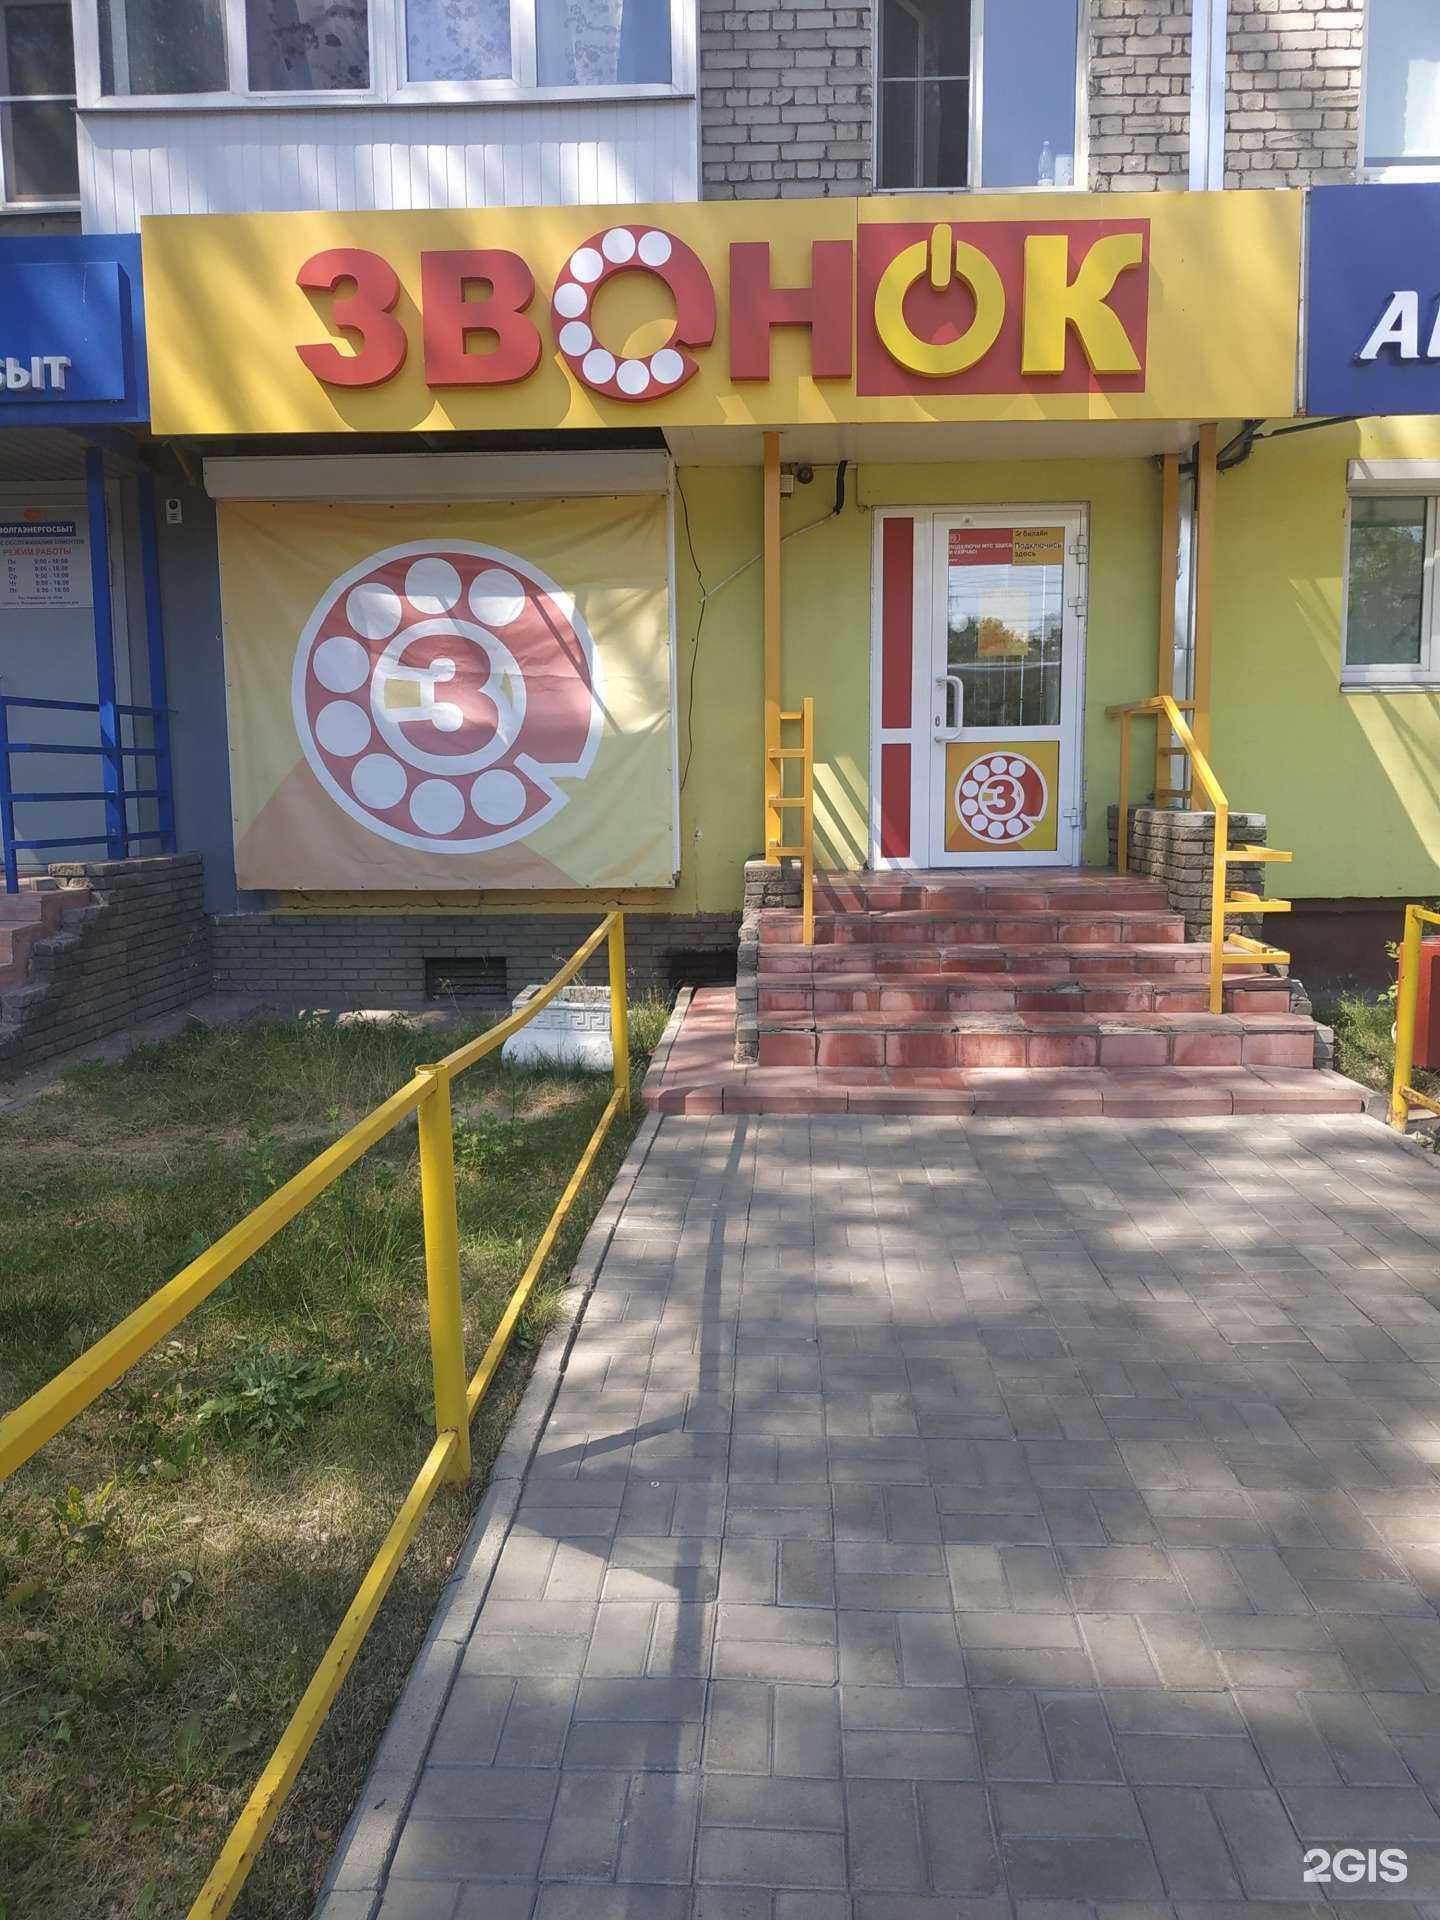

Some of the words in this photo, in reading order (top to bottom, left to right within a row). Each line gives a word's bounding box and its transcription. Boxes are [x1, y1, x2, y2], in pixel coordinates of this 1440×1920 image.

[296, 224, 1143, 403] ЗВОНОК
[1360, 291, 1440, 359] А
[3, 547, 33, 556] РЕЖИМ
[36, 546, 72, 555] РАБОТЫ
